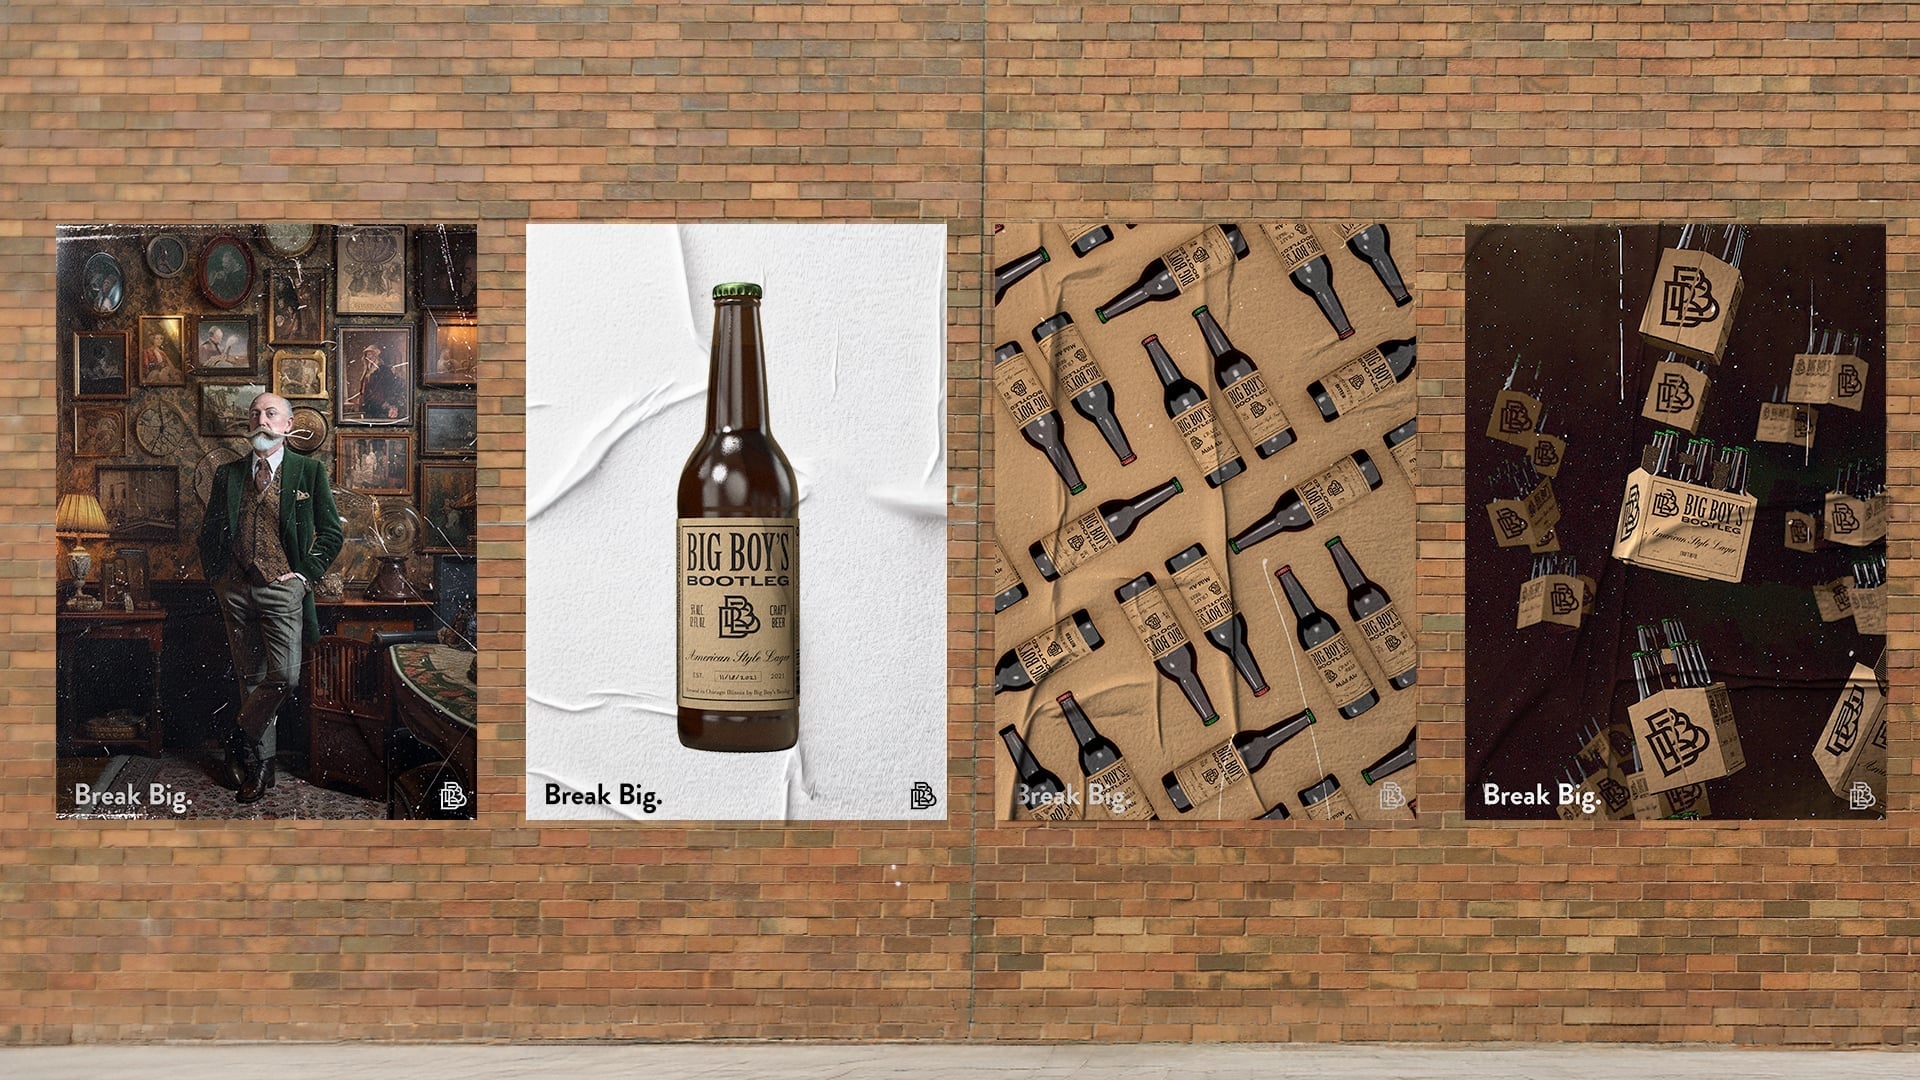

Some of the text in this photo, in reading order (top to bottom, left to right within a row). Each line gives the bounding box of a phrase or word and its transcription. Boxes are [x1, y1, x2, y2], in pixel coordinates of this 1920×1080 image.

[1177, 268, 1195, 286] BIG
[1362, 349, 1382, 366] BIG
[1085, 365, 1101, 381] BIG
[1032, 394, 1050, 411] BIG
[1227, 386, 1244, 404] BIG
[1176, 416, 1191, 433] BIG
[1312, 502, 1329, 519] BIG
[1684, 494, 1745, 526] BIG BOY'S
[1081, 511, 1099, 529] BIG
[1681, 516, 1741, 535] BOOTLEG
[1645, 527, 1737, 555] American Style Lager
[687, 533, 789, 571] BIG BOY'S
[687, 576, 789, 586] BOOTLEG
[1166, 626, 1184, 644] BIG
[1361, 619, 1378, 637] BIG
[685, 649, 730, 662] American
[733, 650, 761, 666] Style
[1310, 650, 1326, 665] BIG
[1215, 744, 1233, 762] BIG
[75, 783, 192, 814] Break Big.
[545, 783, 662, 814] Break Big.
[1015, 783, 1132, 814] Break Big.
[1484, 783, 1550, 805] Break
[1558, 783, 1602, 814] Big.
